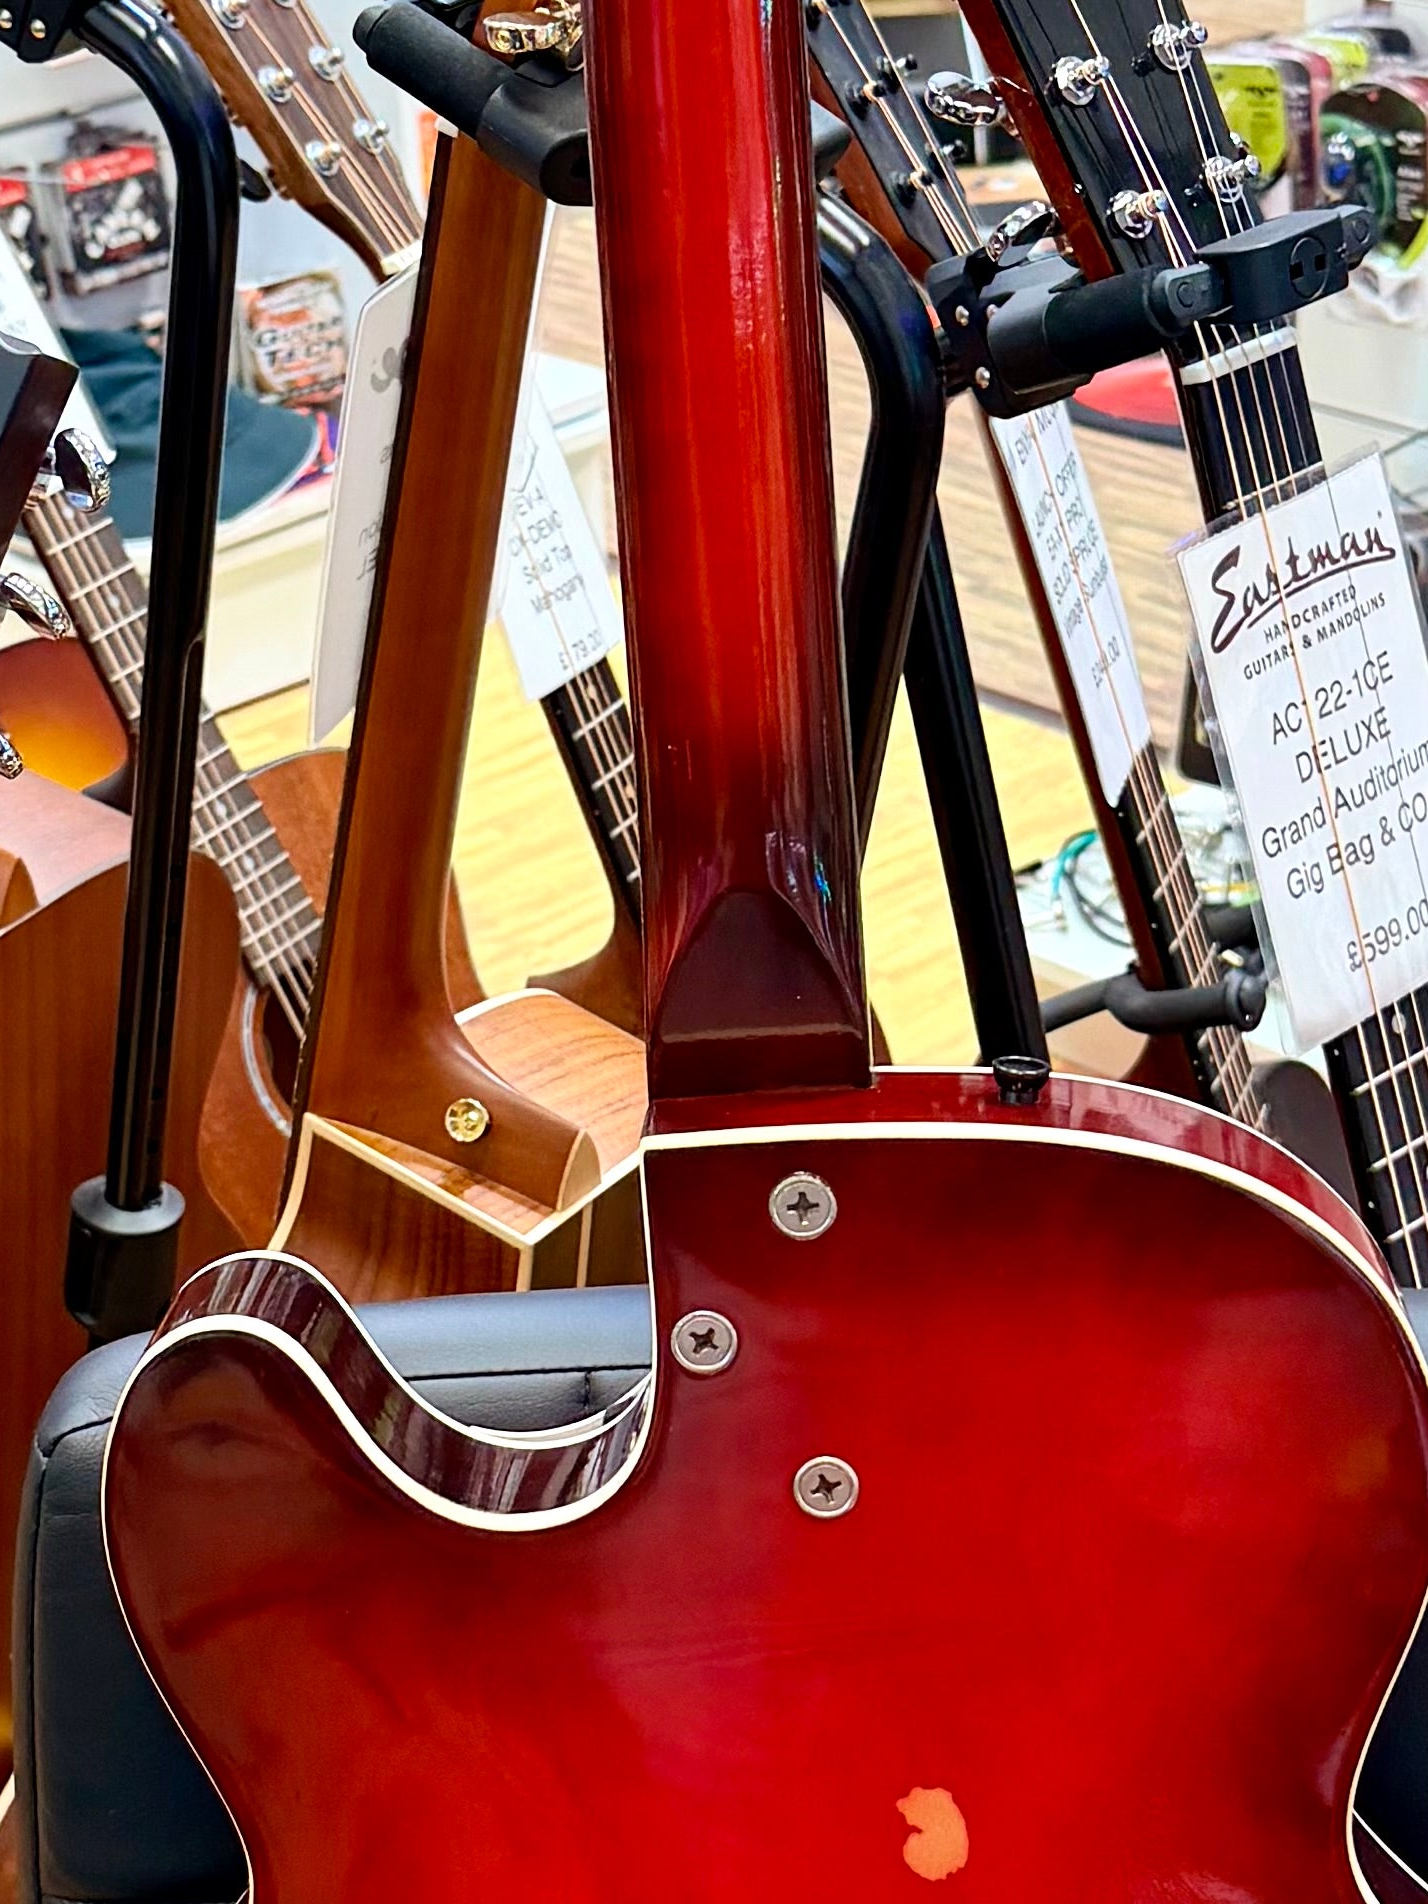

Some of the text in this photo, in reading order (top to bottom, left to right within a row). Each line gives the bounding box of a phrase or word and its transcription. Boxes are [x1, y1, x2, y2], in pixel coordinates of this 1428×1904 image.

[1211, 522, 1397, 654] Eastman
[1263, 584, 1357, 644] HANDCRAFTED
[1244, 592, 1387, 681] GUITARS & MANDOLINS
[1295, 707, 1391, 784] DELUXE
[1261, 801, 1328, 860] Grand
[1287, 856, 1324, 900] Gig
[1328, 834, 1375, 876] Bag
[1380, 818, 1397, 845] &
